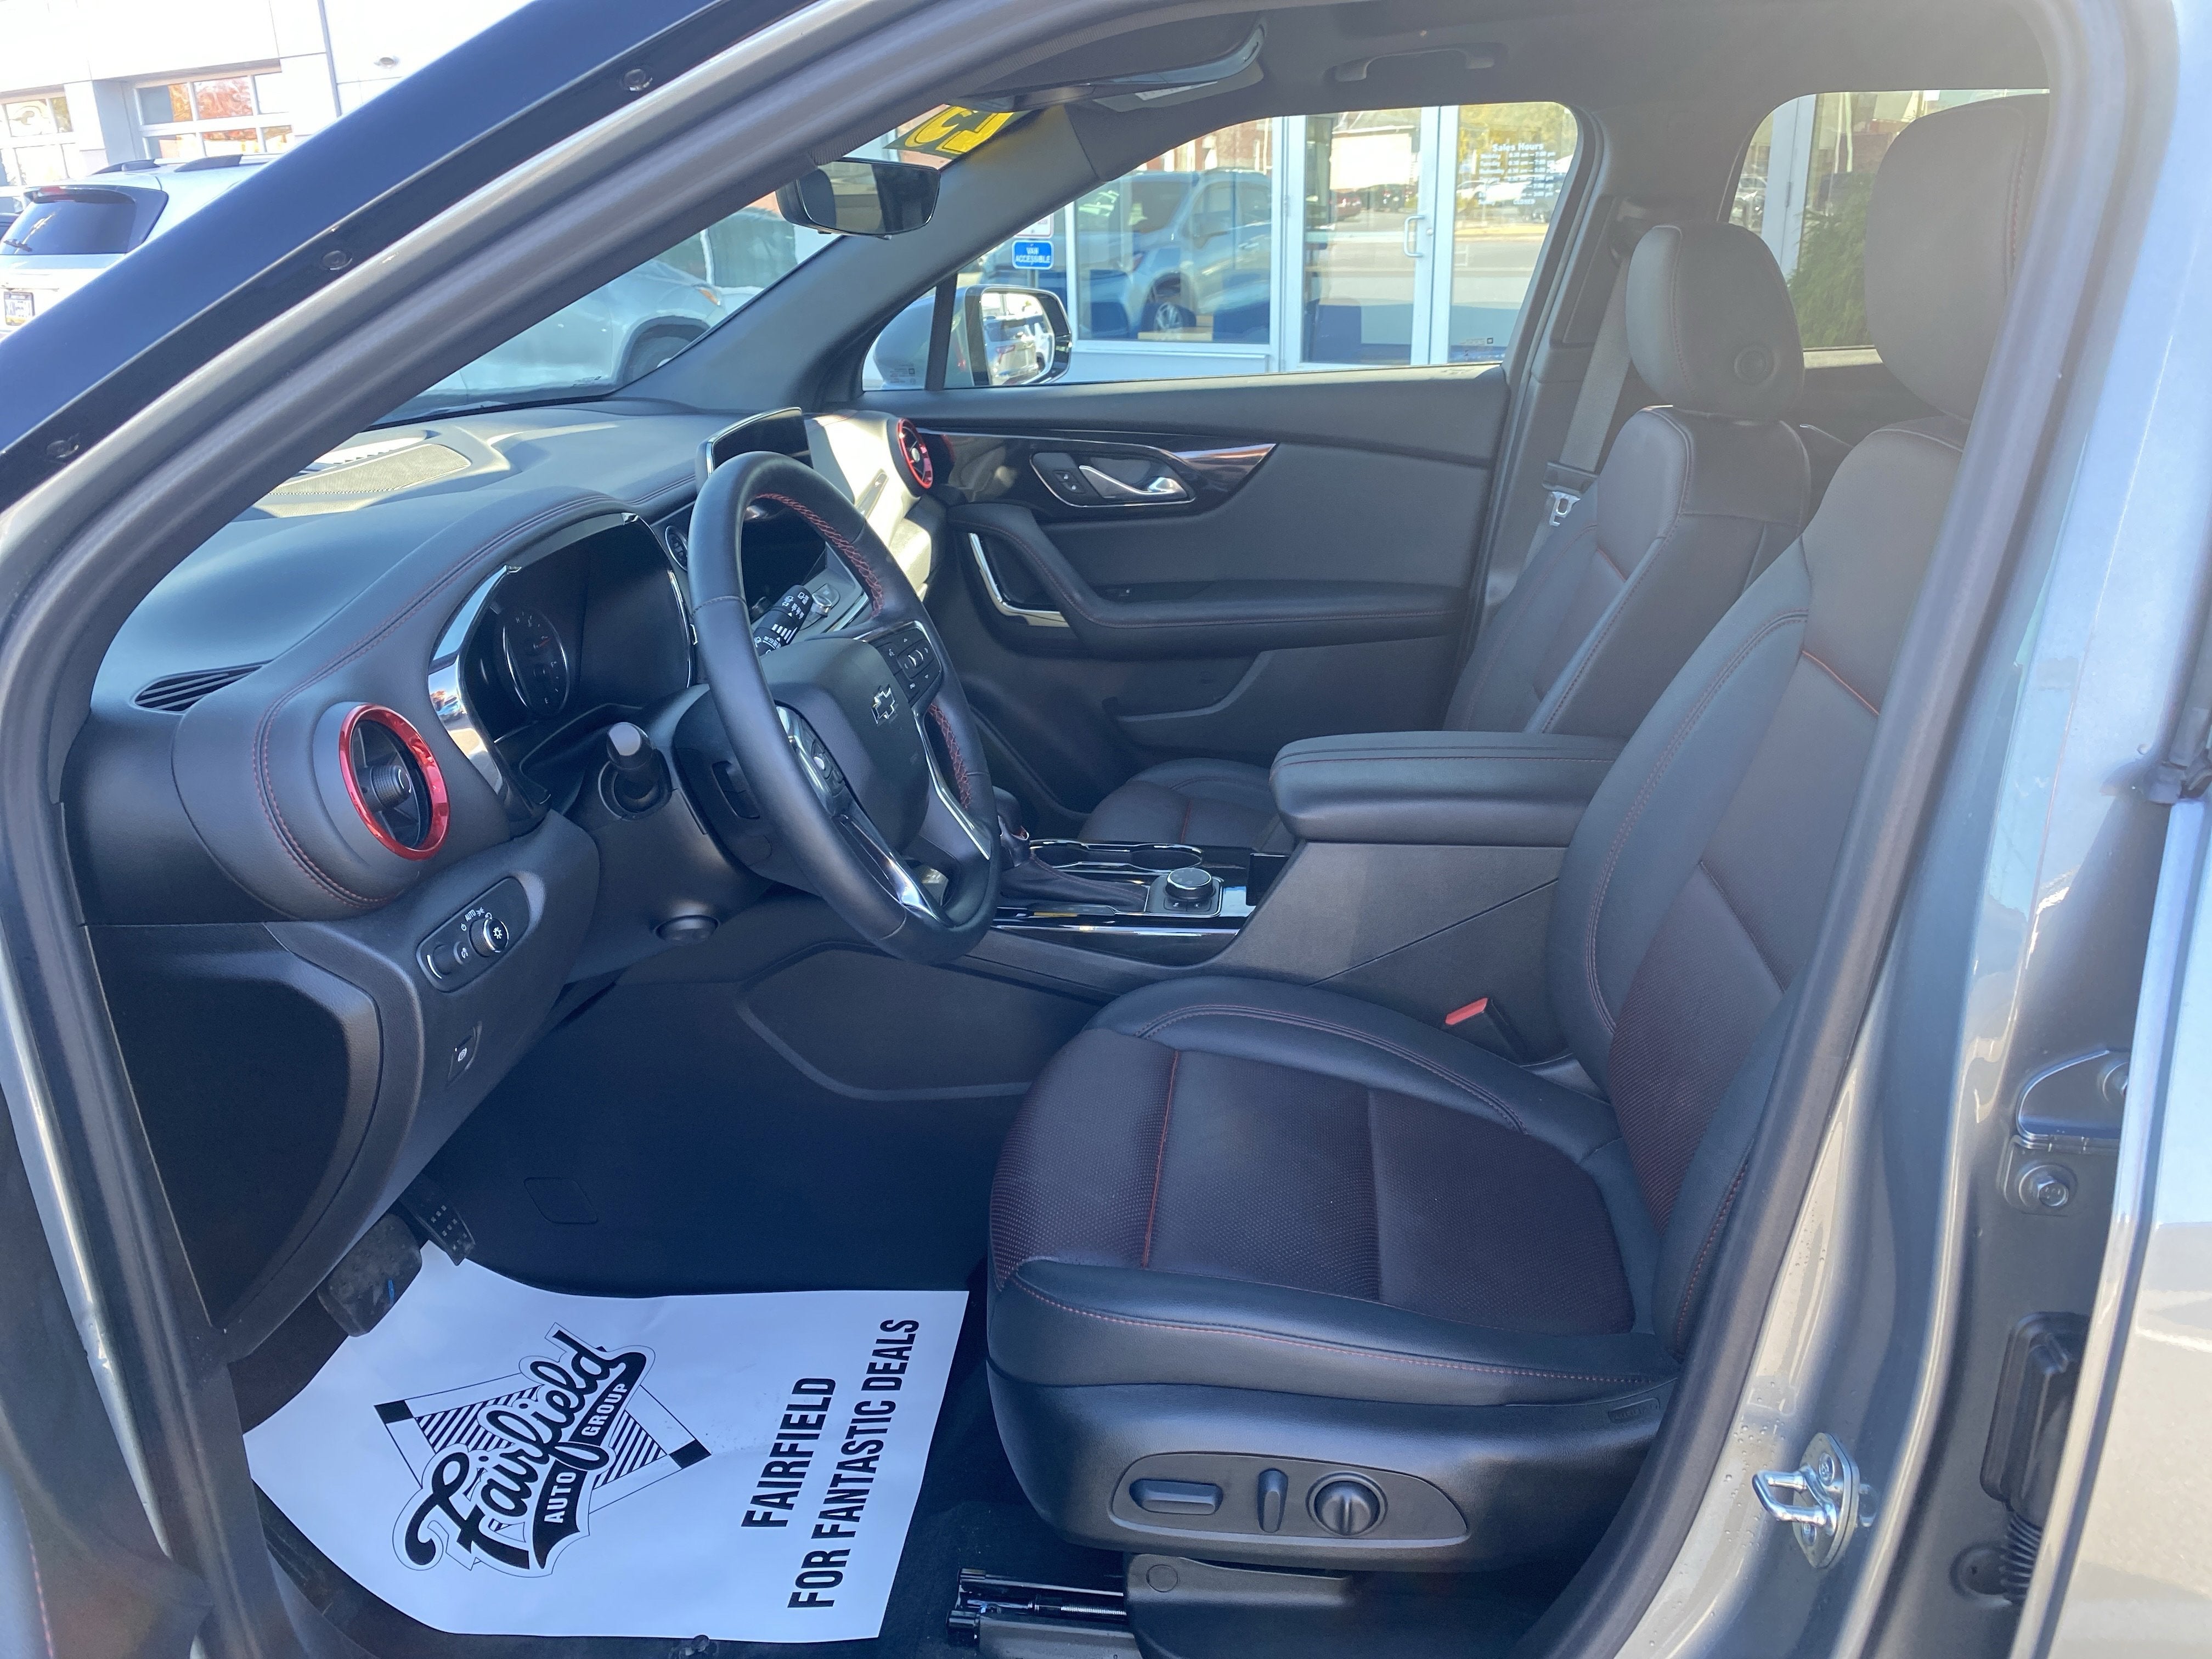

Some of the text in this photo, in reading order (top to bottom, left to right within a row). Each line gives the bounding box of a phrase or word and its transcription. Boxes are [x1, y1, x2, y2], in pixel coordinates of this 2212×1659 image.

[1492, 143, 1544, 152] Sales Hours
[464, 909, 476, 922] AUTO
[405, 1330, 646, 1569] Fairfield
[544, 1383, 628, 1523] AUTO GROUP
[741, 1378, 836, 1527] FAIRFIELD
[787, 1319, 919, 1608] FOR FANTASTIC DEALS
